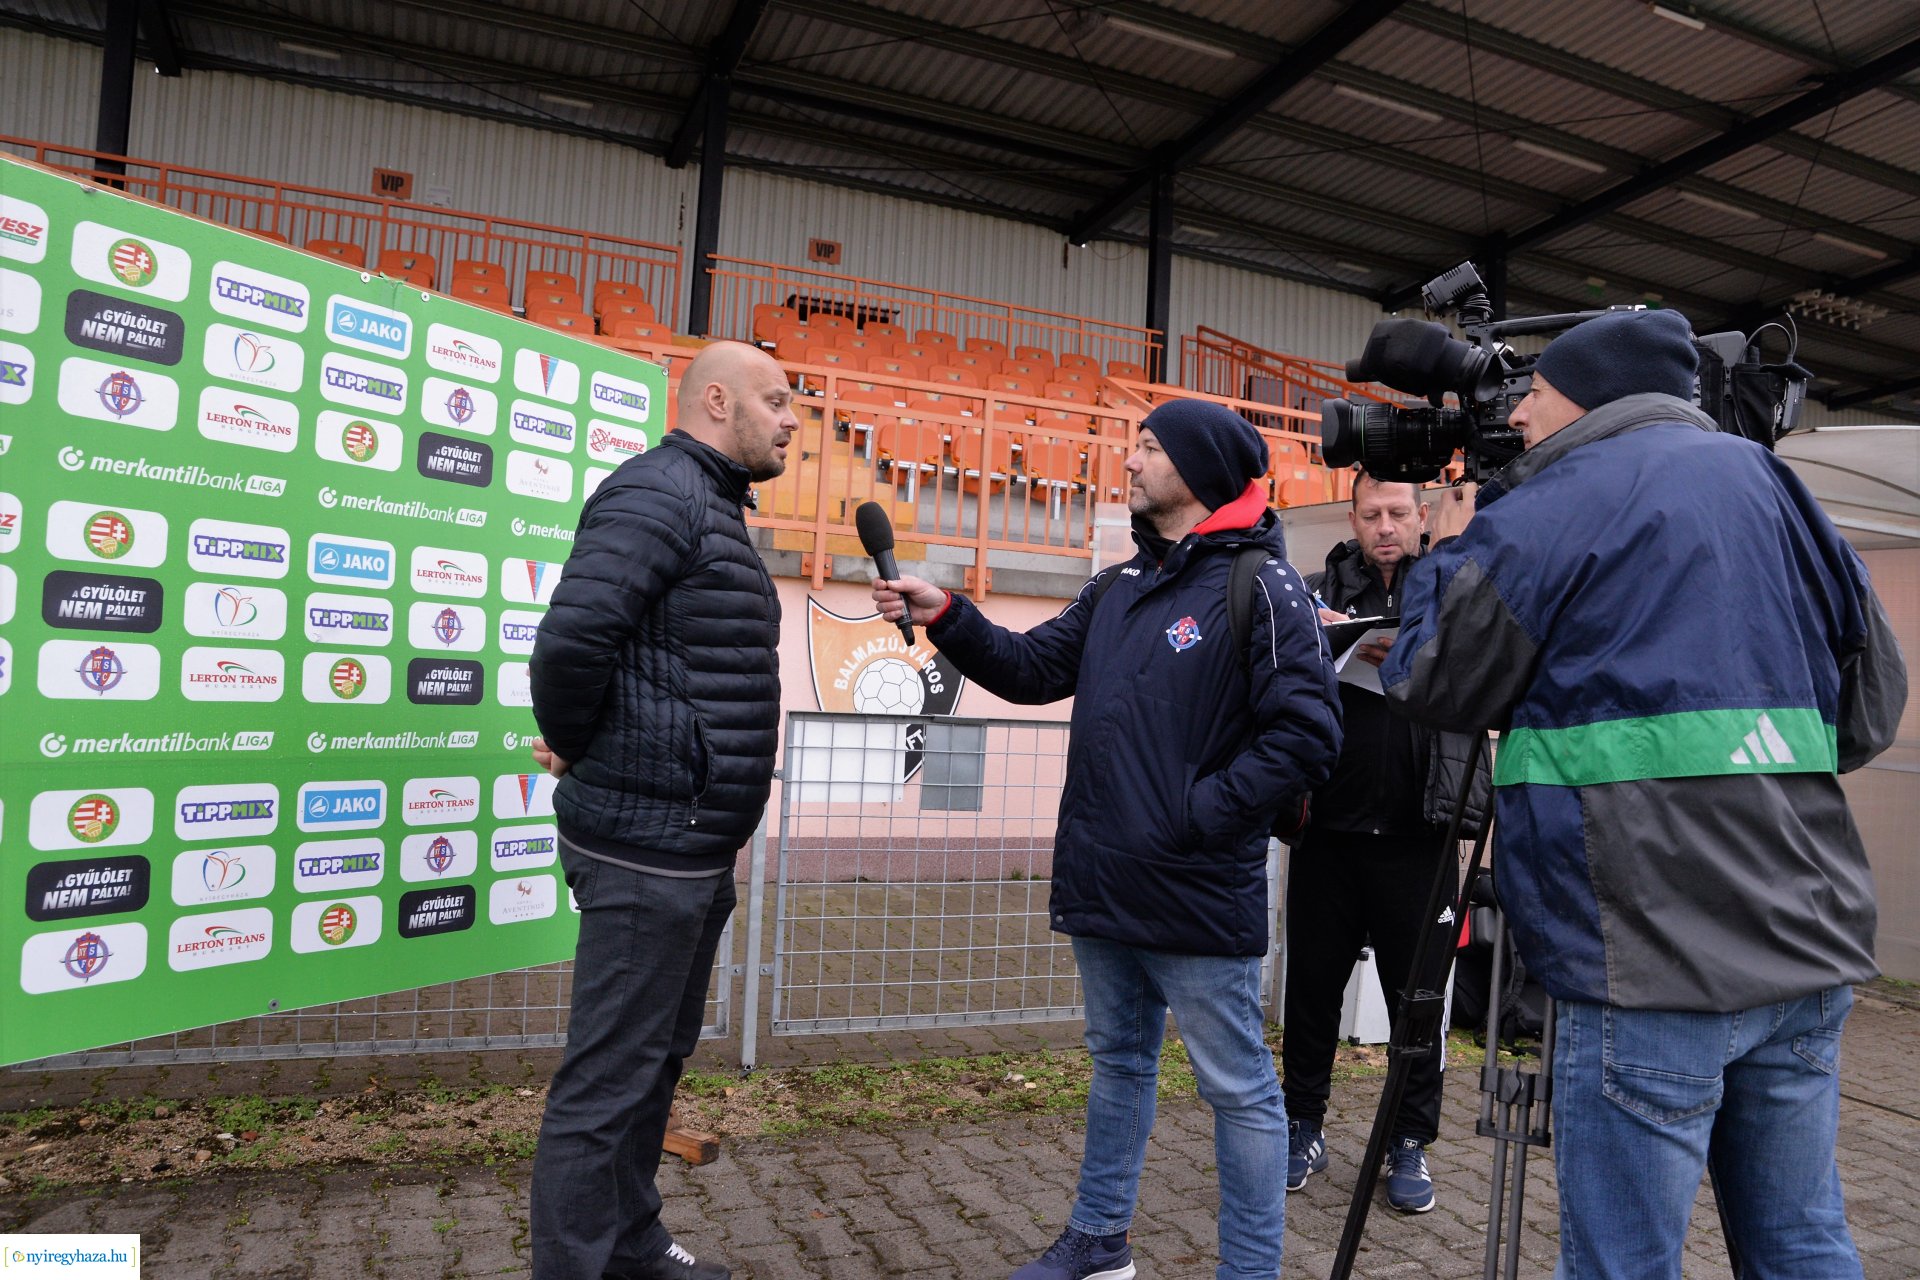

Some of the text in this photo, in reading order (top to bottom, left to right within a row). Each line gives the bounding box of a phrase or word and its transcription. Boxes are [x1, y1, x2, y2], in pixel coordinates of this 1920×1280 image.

[381, 174, 404, 192] VIP
[816, 242, 835, 258] VIP
[80, 319, 166, 349] NEM PÁLYA!
[359, 318, 402, 342] JAKO
[432, 345, 467, 361] LERTON
[469, 355, 497, 369] TRANS
[206, 412, 292, 436] LERTON TRANS
[427, 455, 455, 473] NEM
[250, 478, 282, 493] LIGA
[459, 512, 484, 524] LIGA
[343, 553, 385, 572] JAKO
[417, 569, 452, 580] LERTON
[454, 573, 483, 583] TRANS
[1121, 568, 1140, 577] AKO
[58, 599, 145, 620] NEM PÁLYA!
[190, 673, 277, 684] LERTON TRANS
[417, 681, 445, 696] NEM
[237, 736, 269, 747] LIGA
[451, 734, 475, 745] LIGA
[332, 796, 376, 814] JAKO
[409, 798, 474, 810] LERTON TRANS
[42, 884, 131, 910] NEM PÁLYA!
[409, 912, 437, 929] NEM
[177, 933, 265, 953] LERTON TRANS
